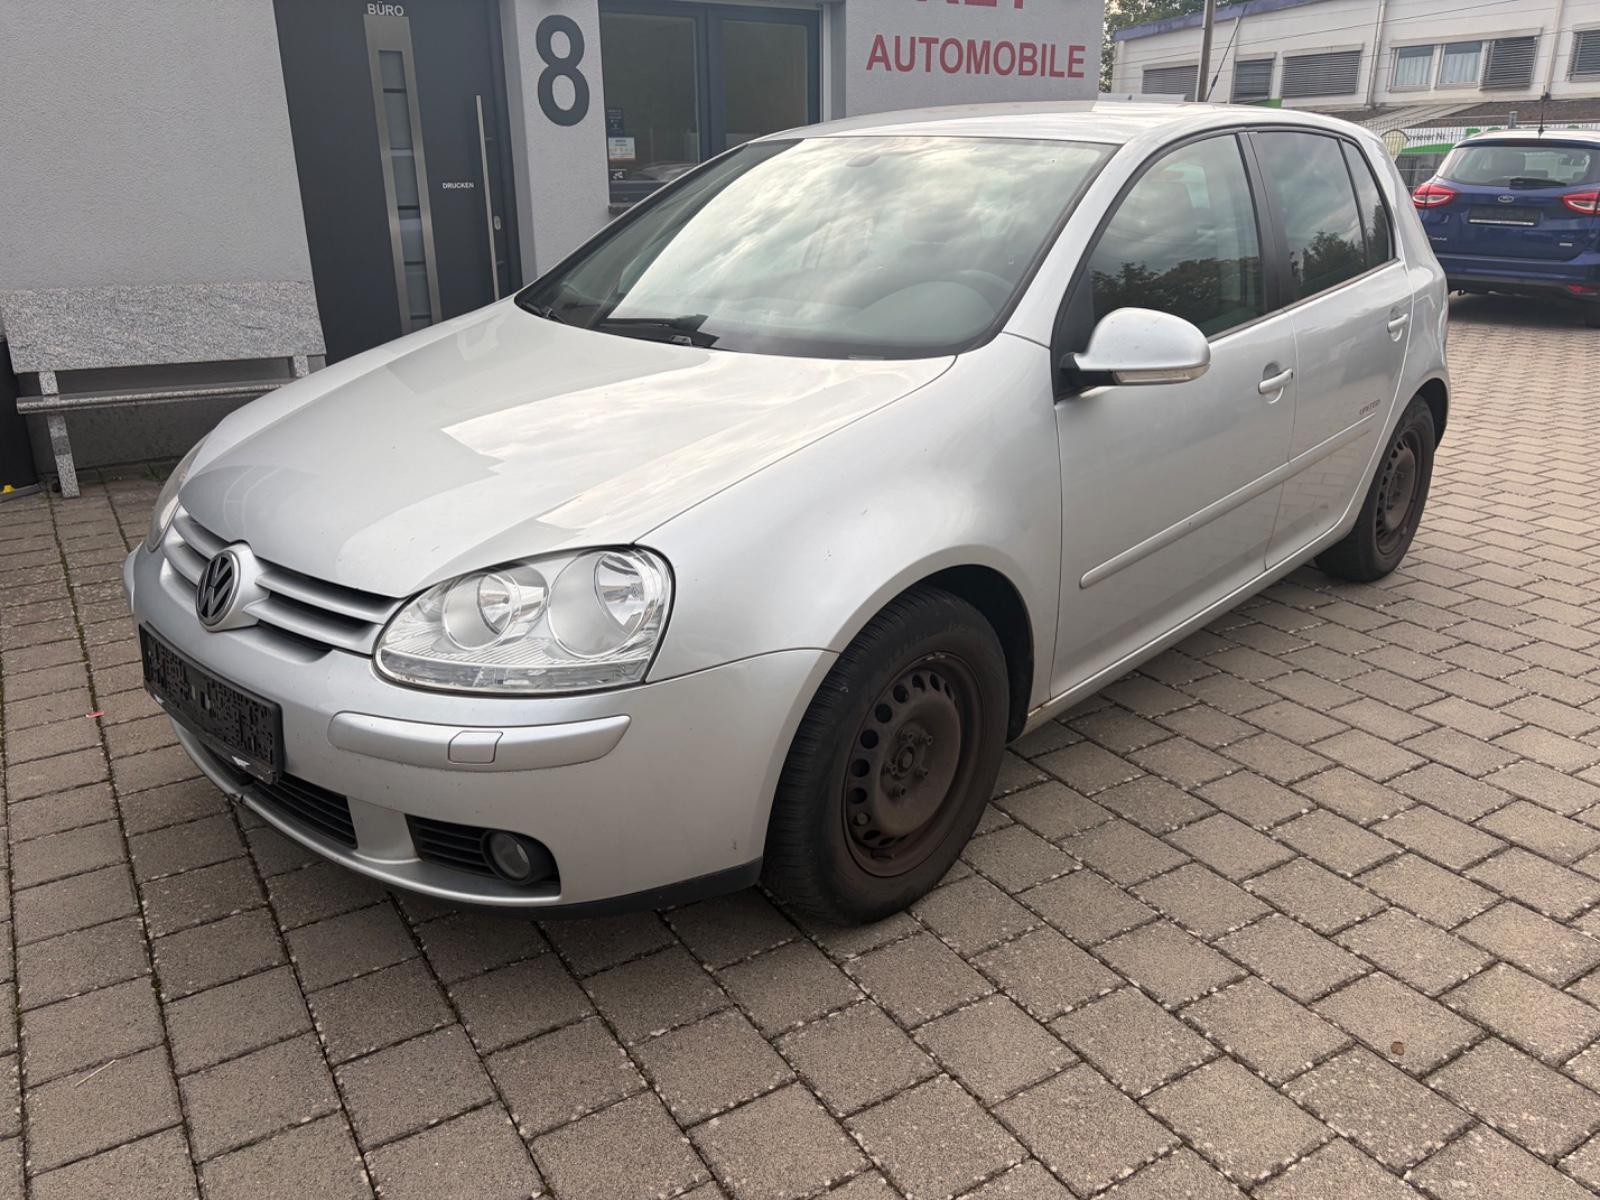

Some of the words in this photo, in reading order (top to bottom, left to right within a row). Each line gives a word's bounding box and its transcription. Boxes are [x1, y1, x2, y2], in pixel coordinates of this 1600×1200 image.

[367, 1, 405, 17] BÜRO
[535, 14, 590, 127] 8
[865, 34, 1087, 78] AUTOMOBILE
[442, 181, 475, 190] DRUCKEN
